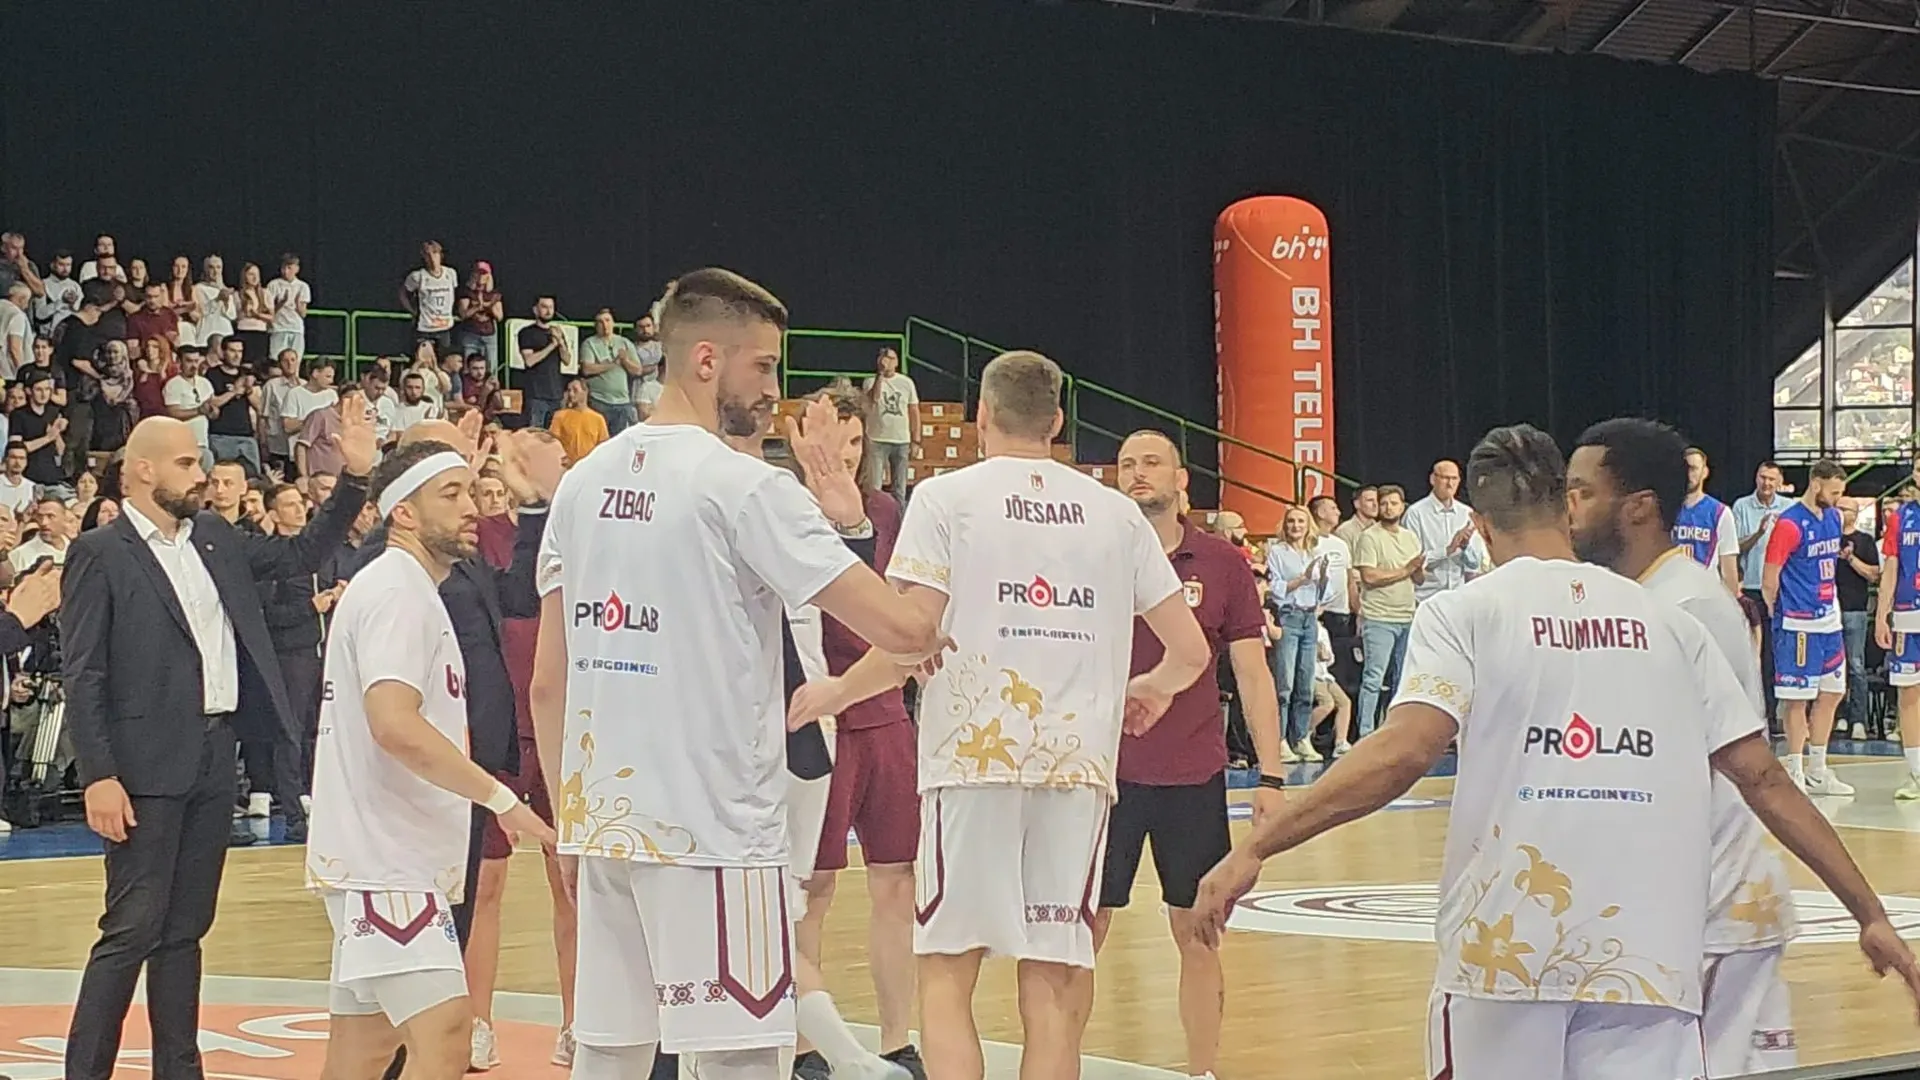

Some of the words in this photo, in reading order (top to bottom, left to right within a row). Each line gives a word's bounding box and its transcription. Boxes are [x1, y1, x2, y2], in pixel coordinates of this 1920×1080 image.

[1292, 287, 1321, 350] BH
[998, 574, 1095, 608] PROLAB
[574, 589, 660, 633] PROLAB
[1532, 616, 1649, 651] PLUMMER
[1523, 712, 1655, 760] PROLAB
[1537, 788, 1654, 804] ENERGOINVEST
